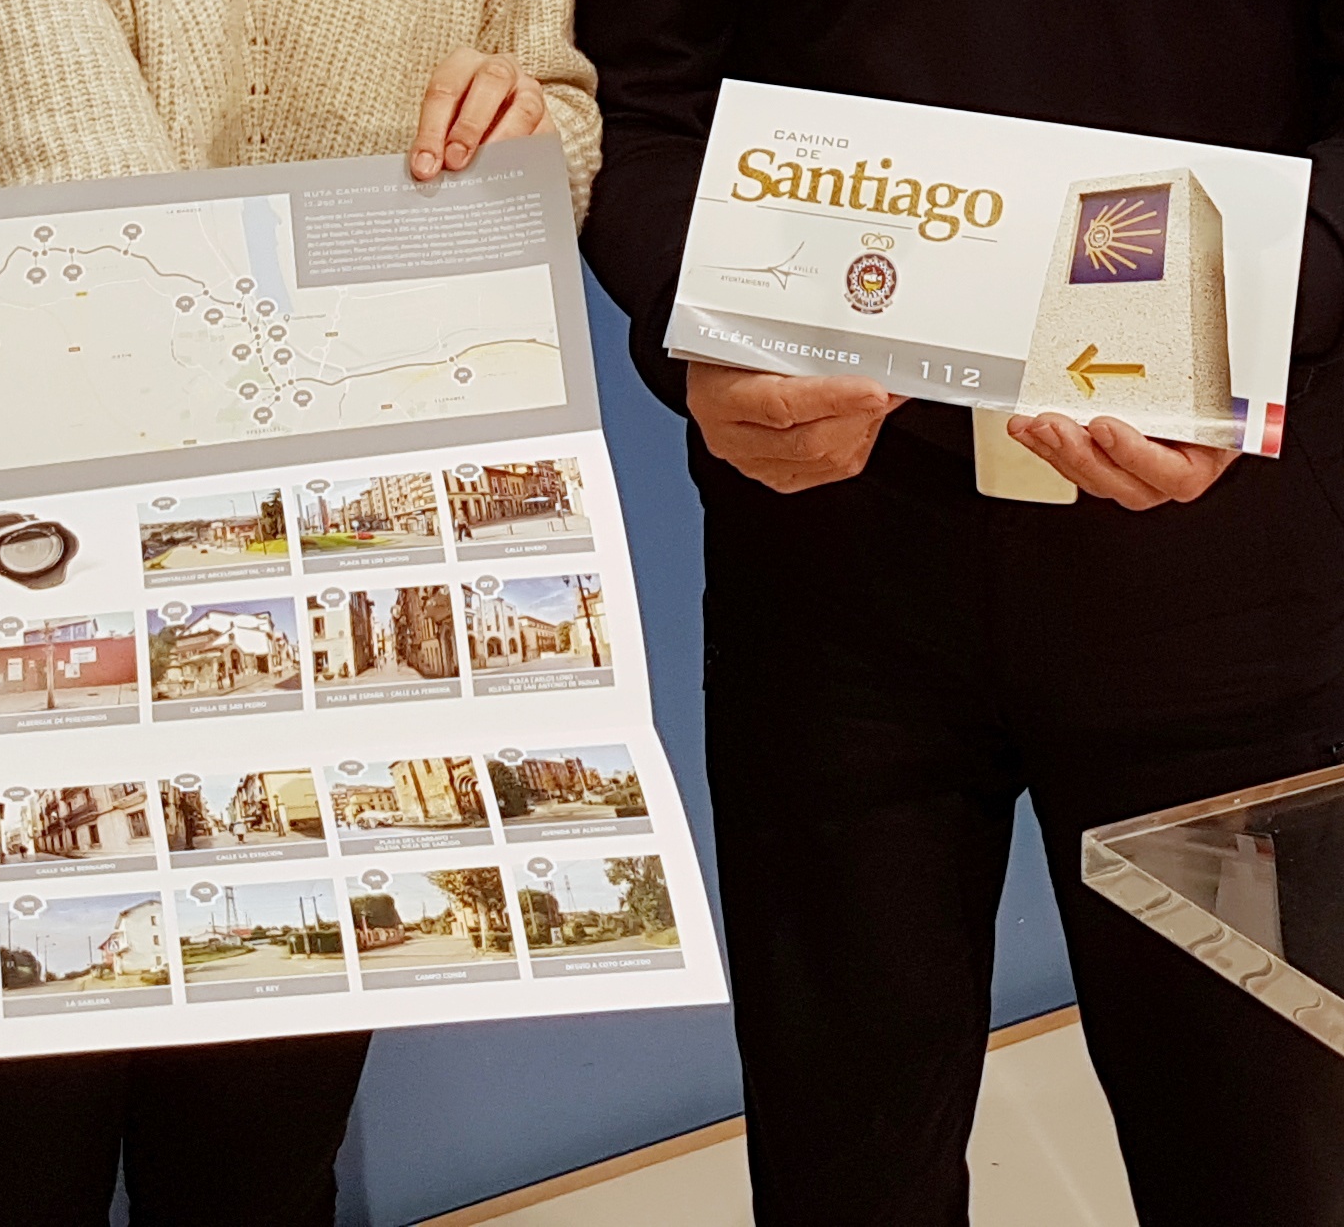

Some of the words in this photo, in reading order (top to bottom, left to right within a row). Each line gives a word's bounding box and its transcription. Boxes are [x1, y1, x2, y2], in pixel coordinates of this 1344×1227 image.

[774, 129, 849, 149] CAMINO
[796, 147, 821, 160] DE
[730, 147, 1004, 242] Santiago
[761, 338, 861, 365] URGENCES
[920, 361, 980, 388] 112
